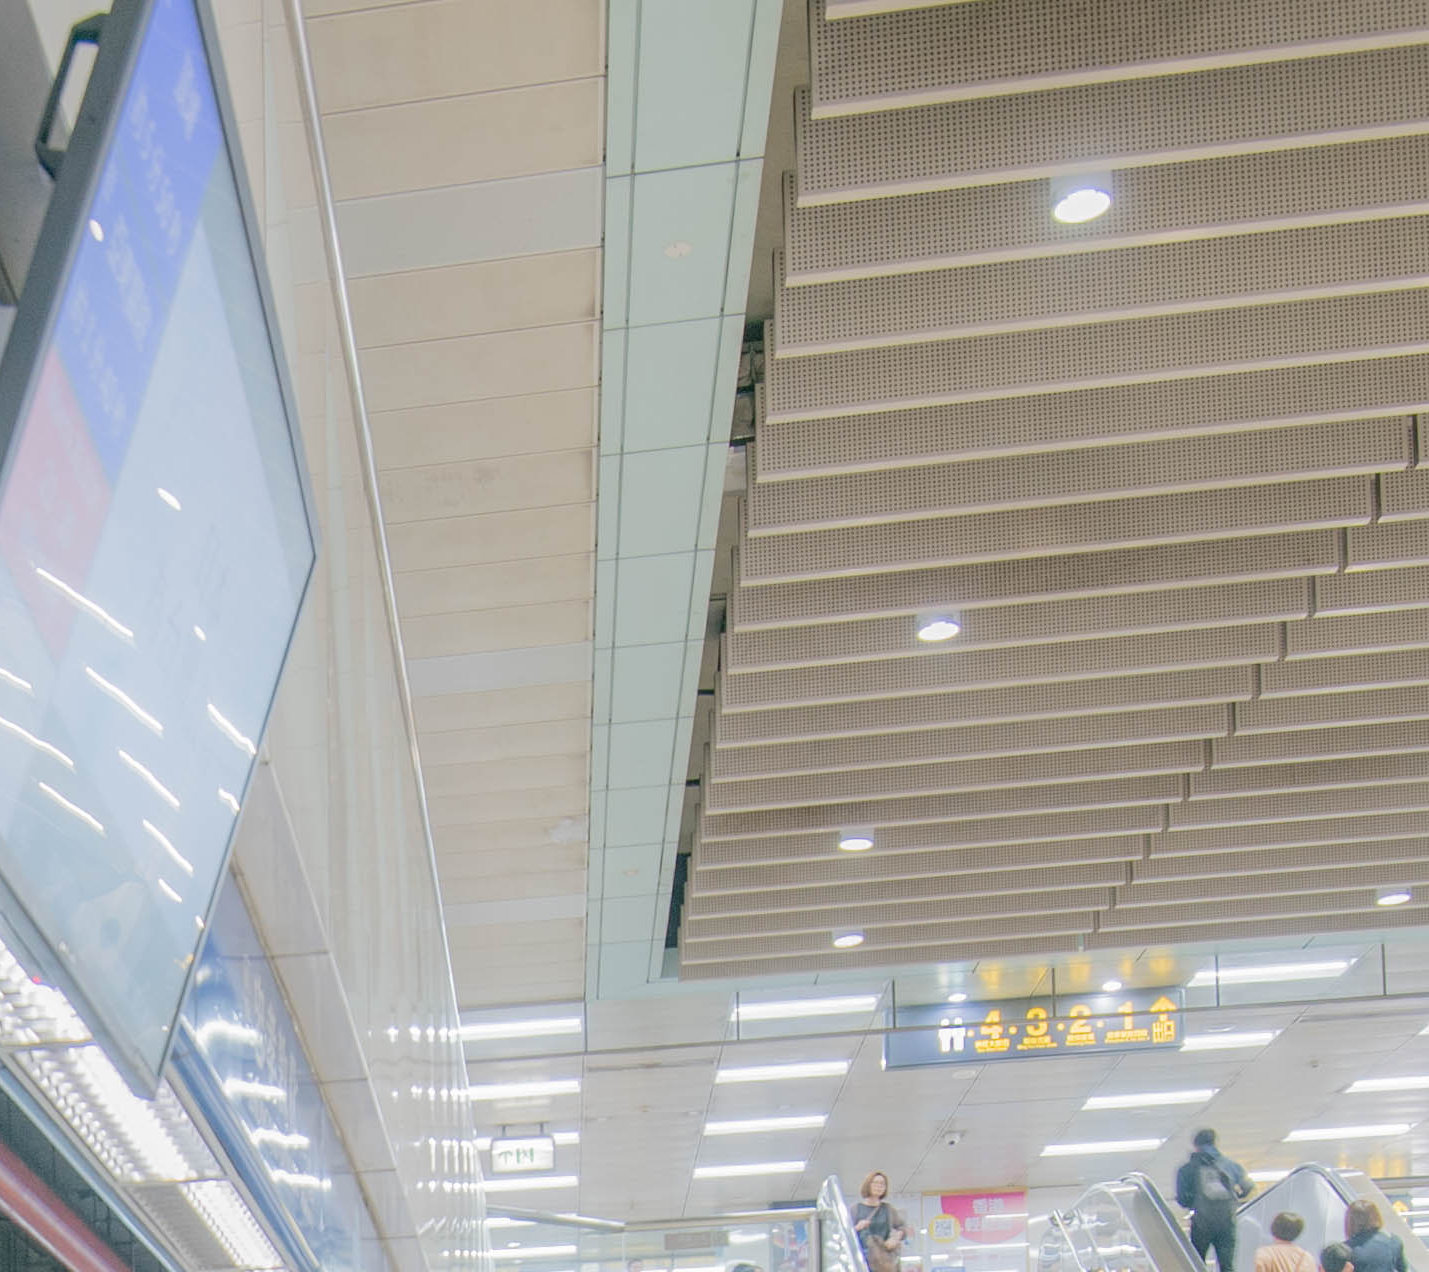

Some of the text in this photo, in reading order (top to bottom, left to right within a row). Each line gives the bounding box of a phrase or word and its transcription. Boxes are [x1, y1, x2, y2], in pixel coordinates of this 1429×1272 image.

[979, 1000, 1134, 1040] 4 3 2 1
